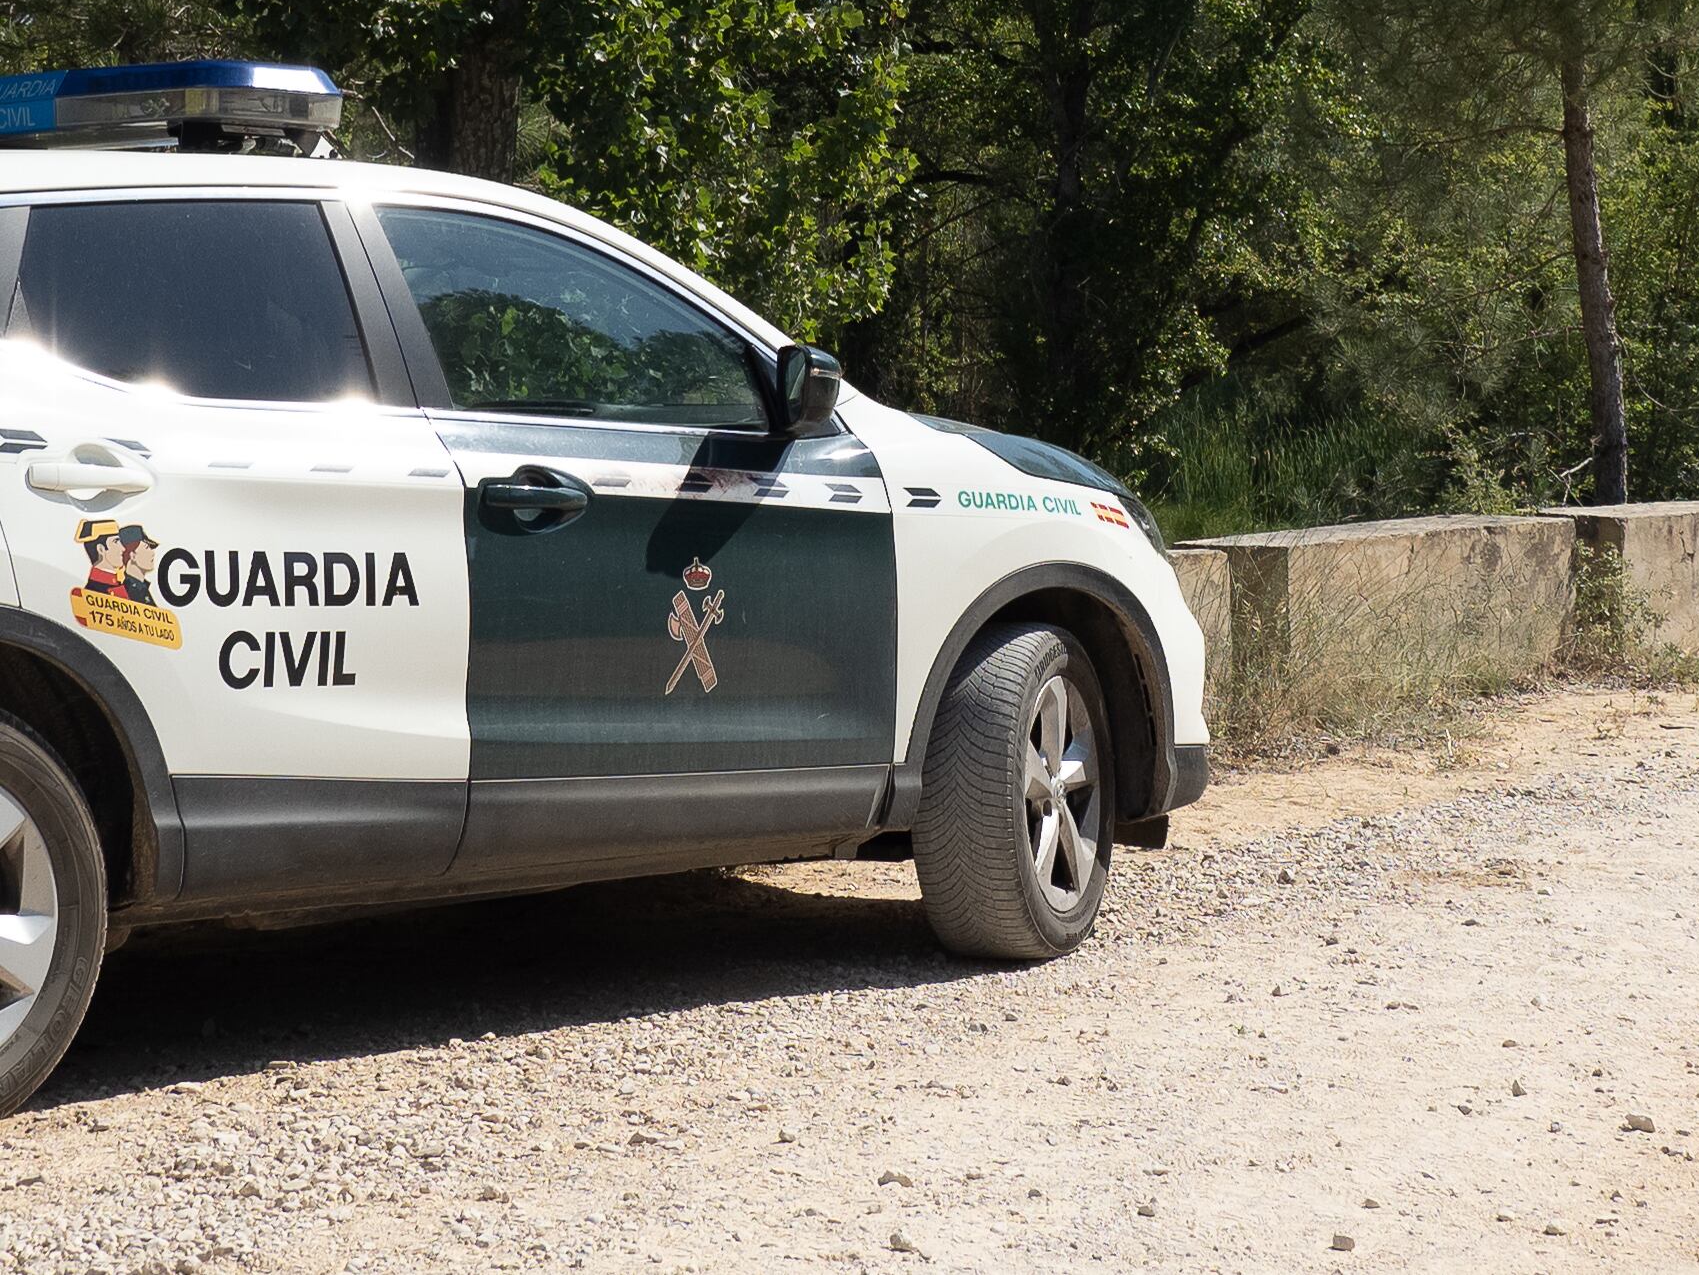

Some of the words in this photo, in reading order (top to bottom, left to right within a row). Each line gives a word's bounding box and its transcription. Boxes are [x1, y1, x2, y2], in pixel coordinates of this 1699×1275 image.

[0, 79, 56, 100] UARDIA
[957, 490, 1038, 511] GUARDIA
[1043, 496, 1082, 516] CIVIL
[157, 547, 420, 608] GUARDIA
[85, 594, 141, 617] GUARDIA
[143, 608, 174, 625] CIVIL
[89, 610, 114, 627] 175
[138, 622, 145, 634] A
[145, 623, 155, 638] TU
[156, 627, 175, 641] LADO
[218, 630, 357, 690] CIVIL
